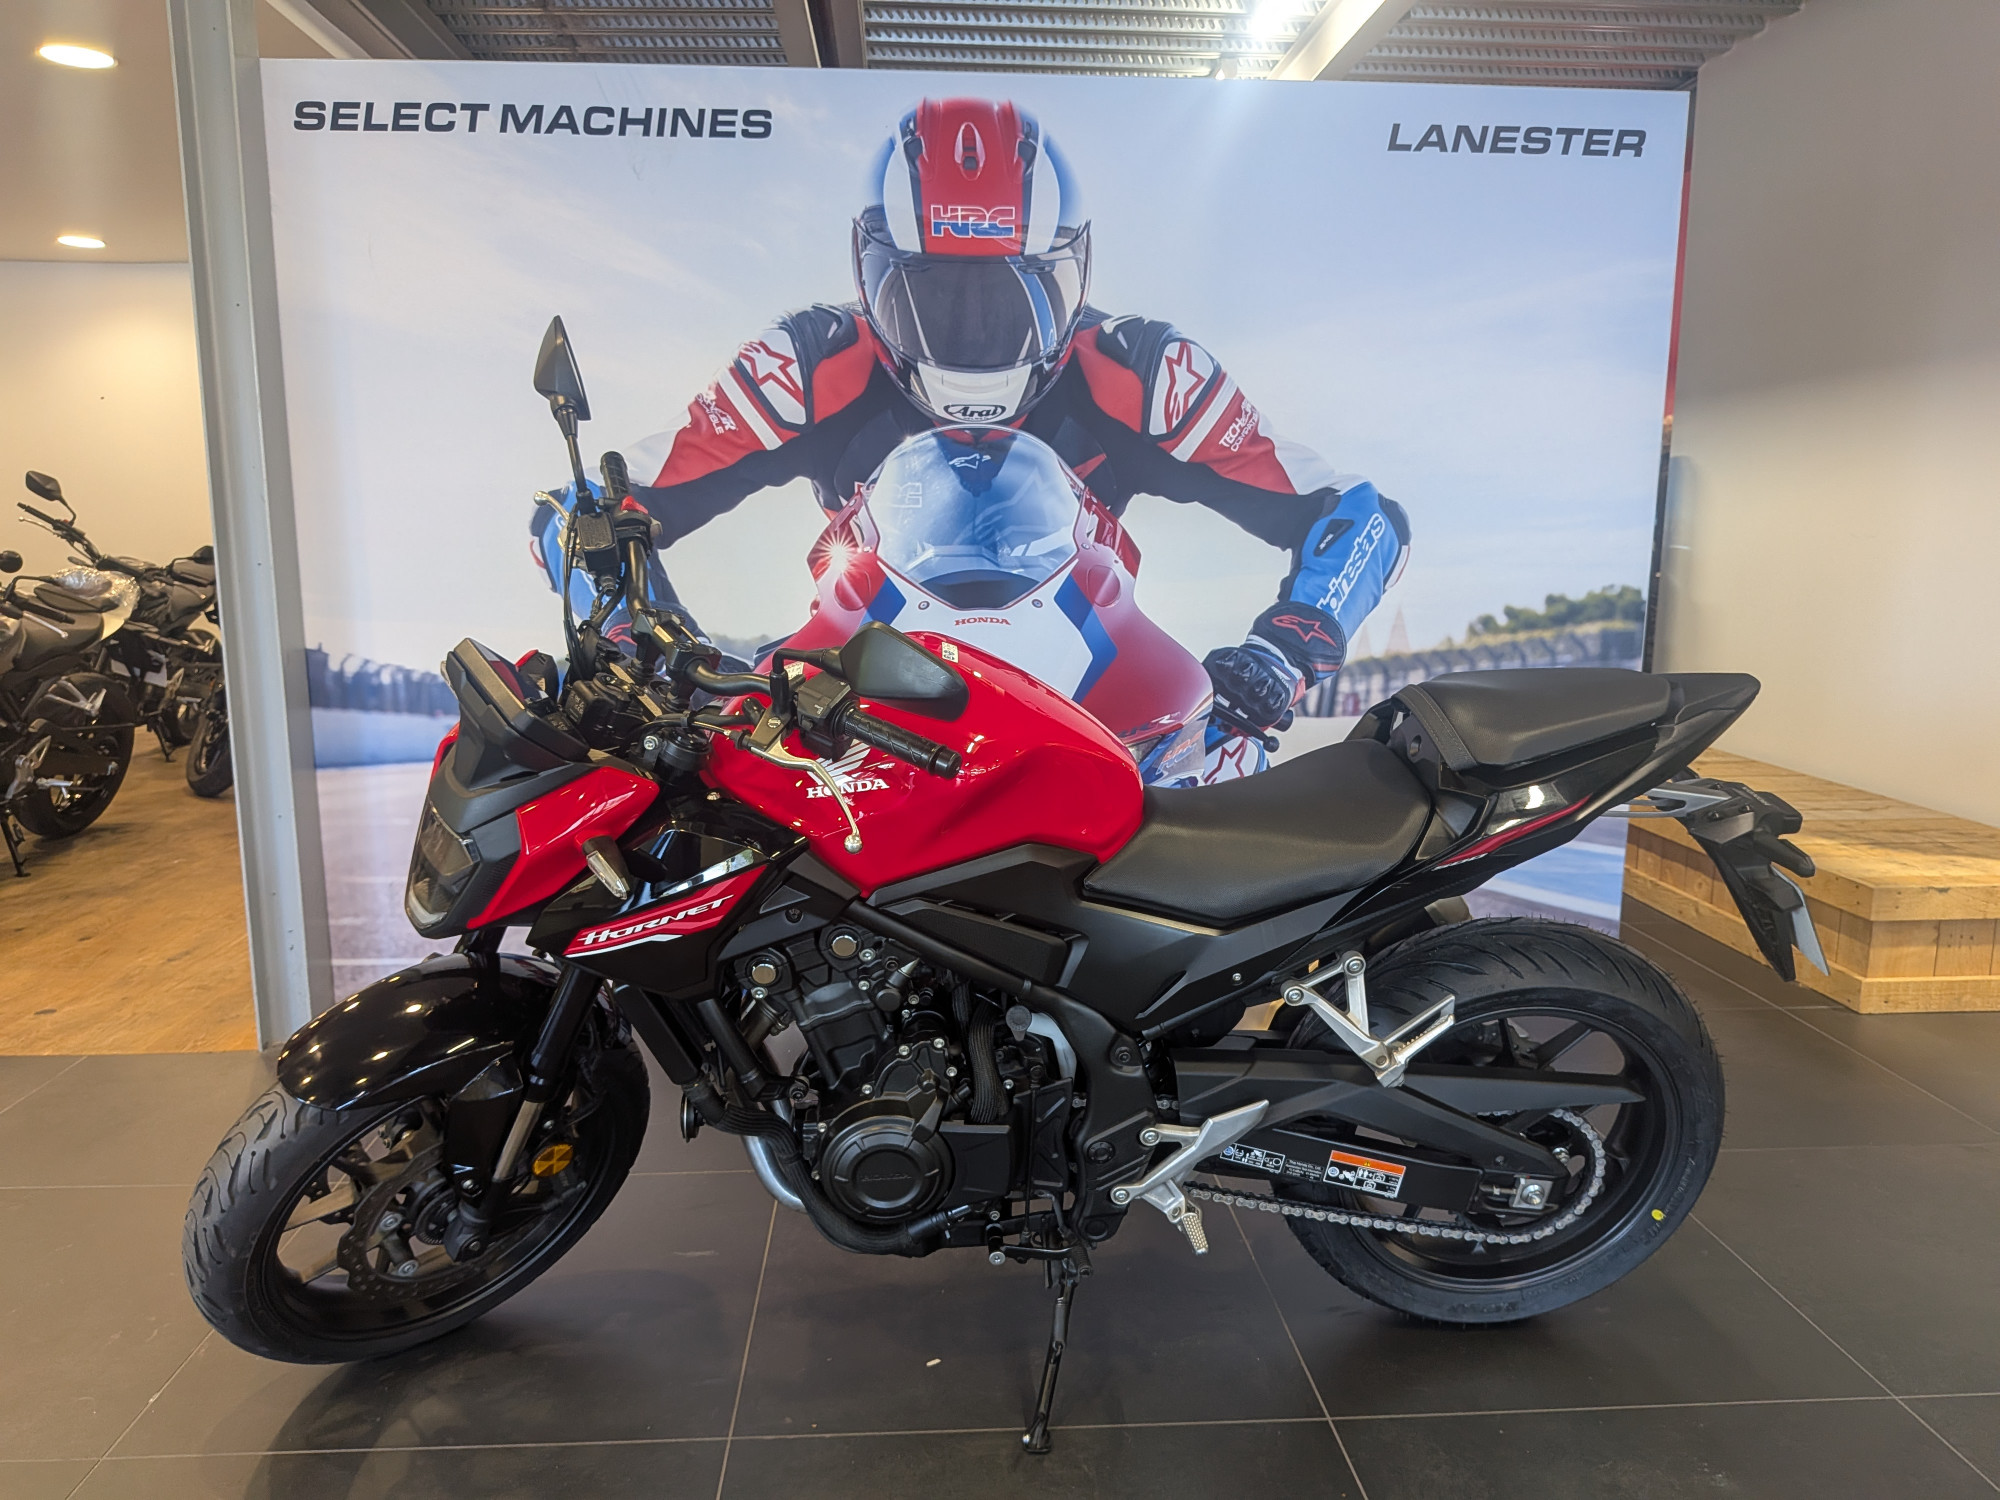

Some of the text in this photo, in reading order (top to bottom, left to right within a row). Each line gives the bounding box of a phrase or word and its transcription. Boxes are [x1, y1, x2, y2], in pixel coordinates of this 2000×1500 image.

[293, 101, 773, 139] SELECT MACHINES
[1387, 122, 1647, 158] LANESTER
[930, 204, 1016, 238] HRC
[950, 406, 999, 418] Arai
[954, 616, 1012, 626] HONDA
[577, 894, 734, 946] HORNET
